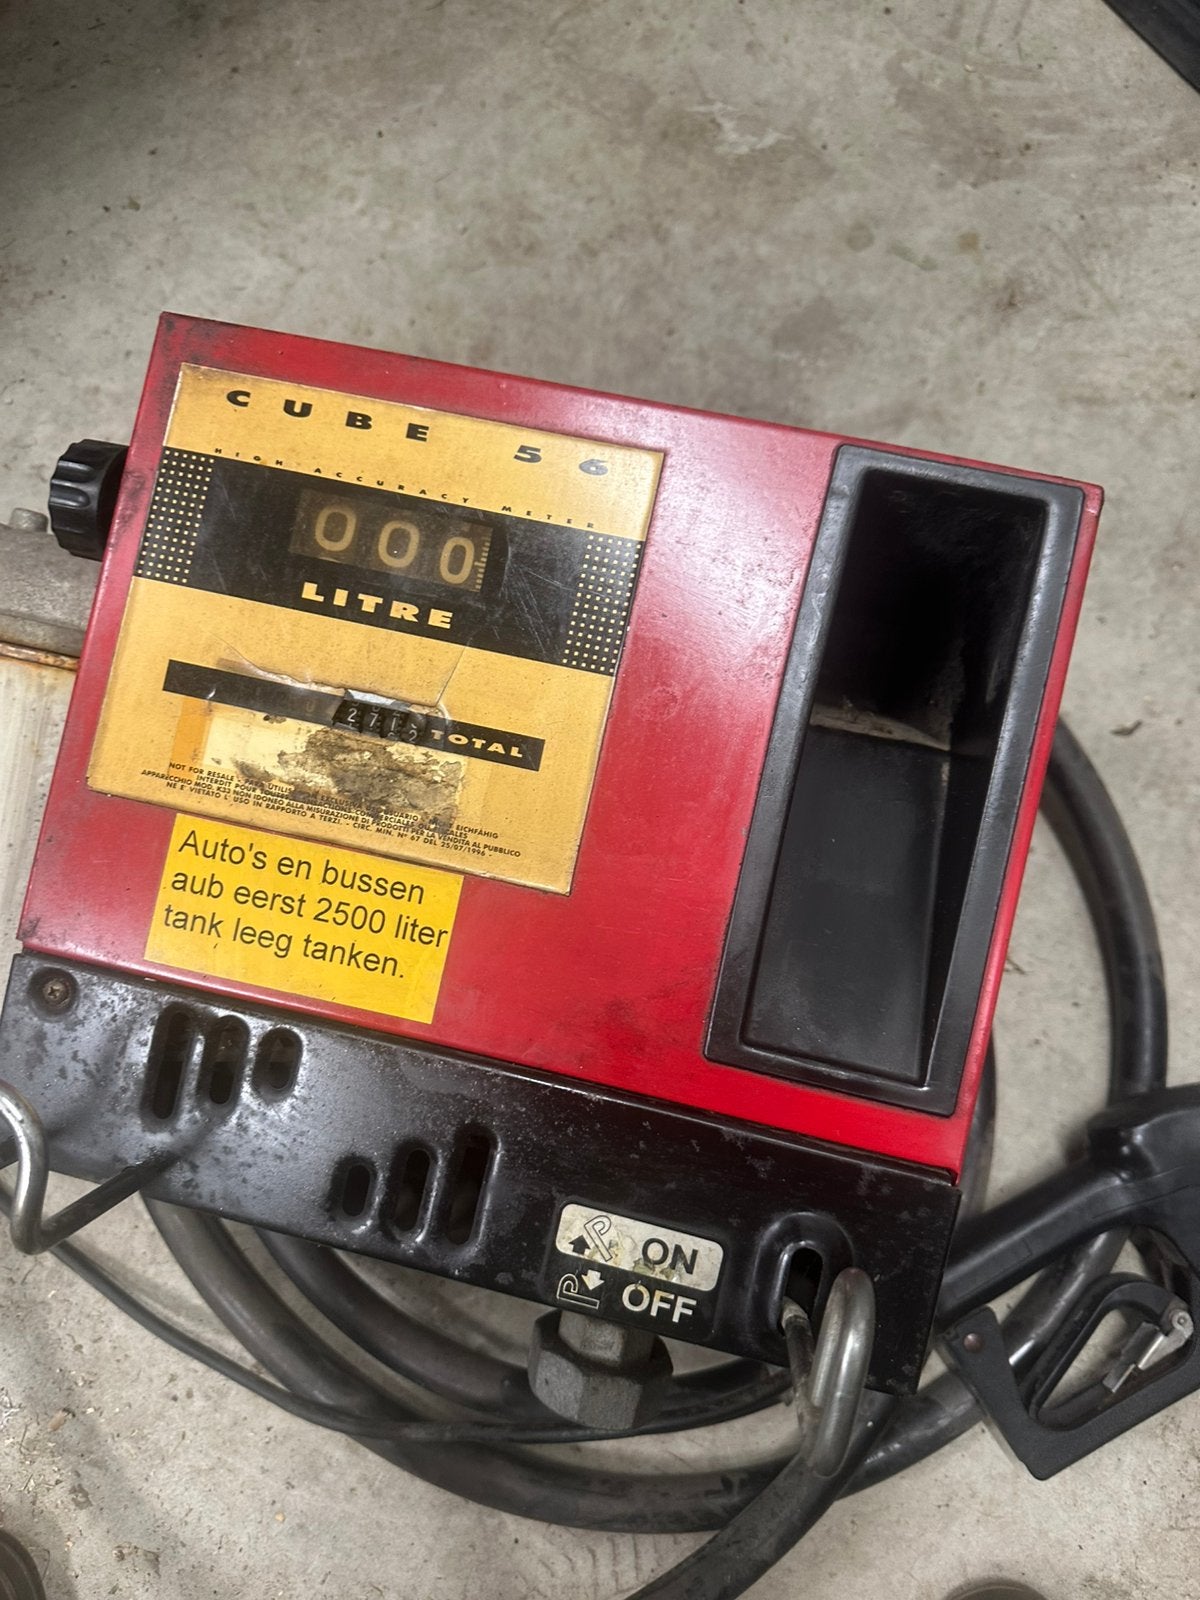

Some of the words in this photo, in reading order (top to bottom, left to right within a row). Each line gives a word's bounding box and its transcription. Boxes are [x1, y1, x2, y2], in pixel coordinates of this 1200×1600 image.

[226, 390, 431, 442] CUBE
[214, 447, 284, 467] HIGH
[314, 467, 470, 504] ACCURACY
[501, 505, 595, 529] METER
[300, 582, 454, 630] LITRE
[431, 729, 524, 759] TOTAL
[168, 761, 185, 770] NOT
[188, 766, 204, 774] FOR
[207, 770, 234, 781] RESALE
[196, 774, 231, 787] INTERDIT
[189, 786, 221, 798] VIETATO
[233, 795, 250, 804] USO
[265, 802, 307, 817] RAPPORTO
[318, 814, 342, 825] TERZI.
[352, 821, 371, 831] CIRC.
[375, 826, 394, 836] MIN.
[423, 837, 437, 845] DEL
[194, 780, 215, 790] MOD.
[232, 788, 251, 798] NON
[253, 793, 284, 805] IDONEO
[285, 800, 304, 809] ALLA
[306, 804, 359, 822] MISURAZIONE
[437, 833, 470, 846] VENDITA
[483, 843, 521, 857] PUBBLICO
[178, 830, 267, 870] Auto's
[277, 855, 312, 880] en
[321, 859, 425, 905] bussen
[171, 872, 224, 899] aub
[233, 884, 306, 918] eerst
[313, 897, 385, 934] 2500
[394, 913, 449, 948] liter
[164, 904, 225, 939] tank
[232, 917, 293, 959] leeg
[303, 933, 404, 979] tanken.
[641, 1237, 699, 1276] ON
[621, 1283, 698, 1324] OFF
